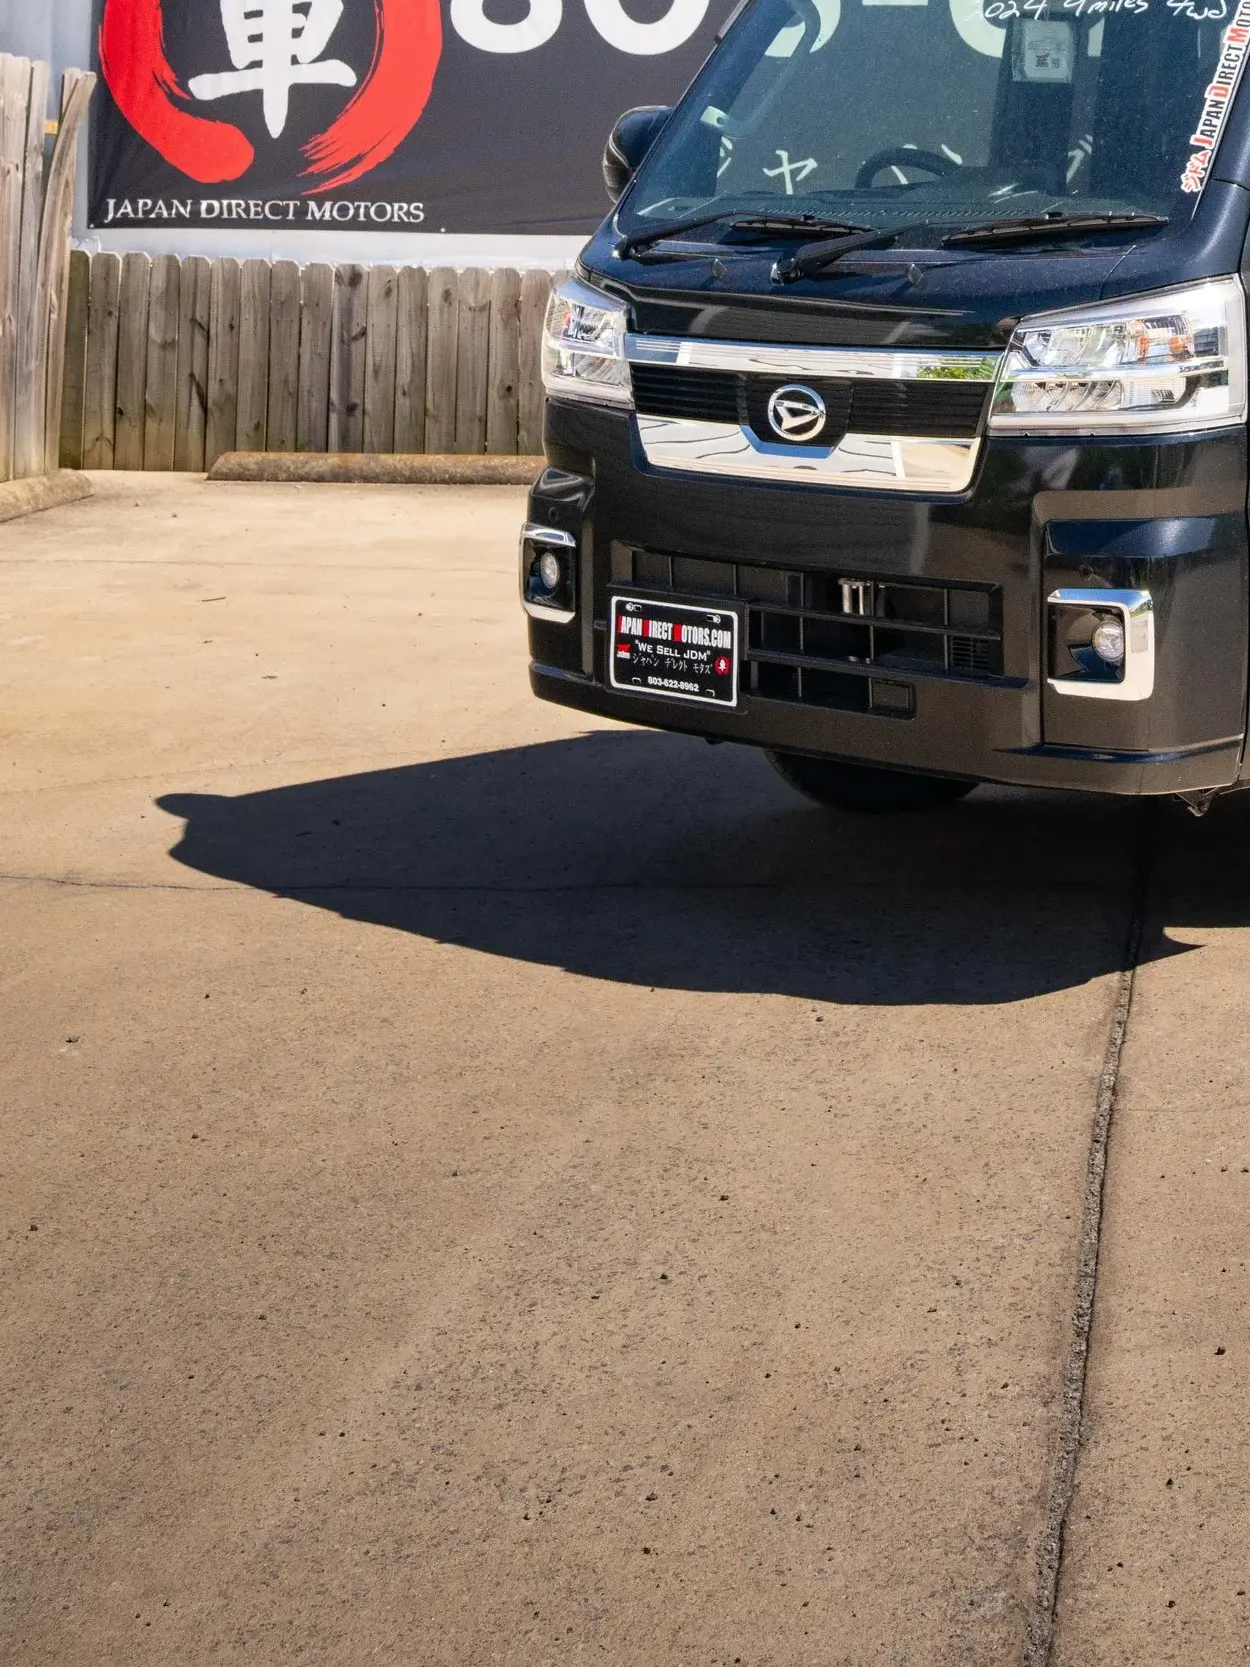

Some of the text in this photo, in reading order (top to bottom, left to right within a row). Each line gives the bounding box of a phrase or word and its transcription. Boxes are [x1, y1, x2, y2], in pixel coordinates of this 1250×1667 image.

[103, 198, 425, 224] JAPAN DIRECT MOTORS
